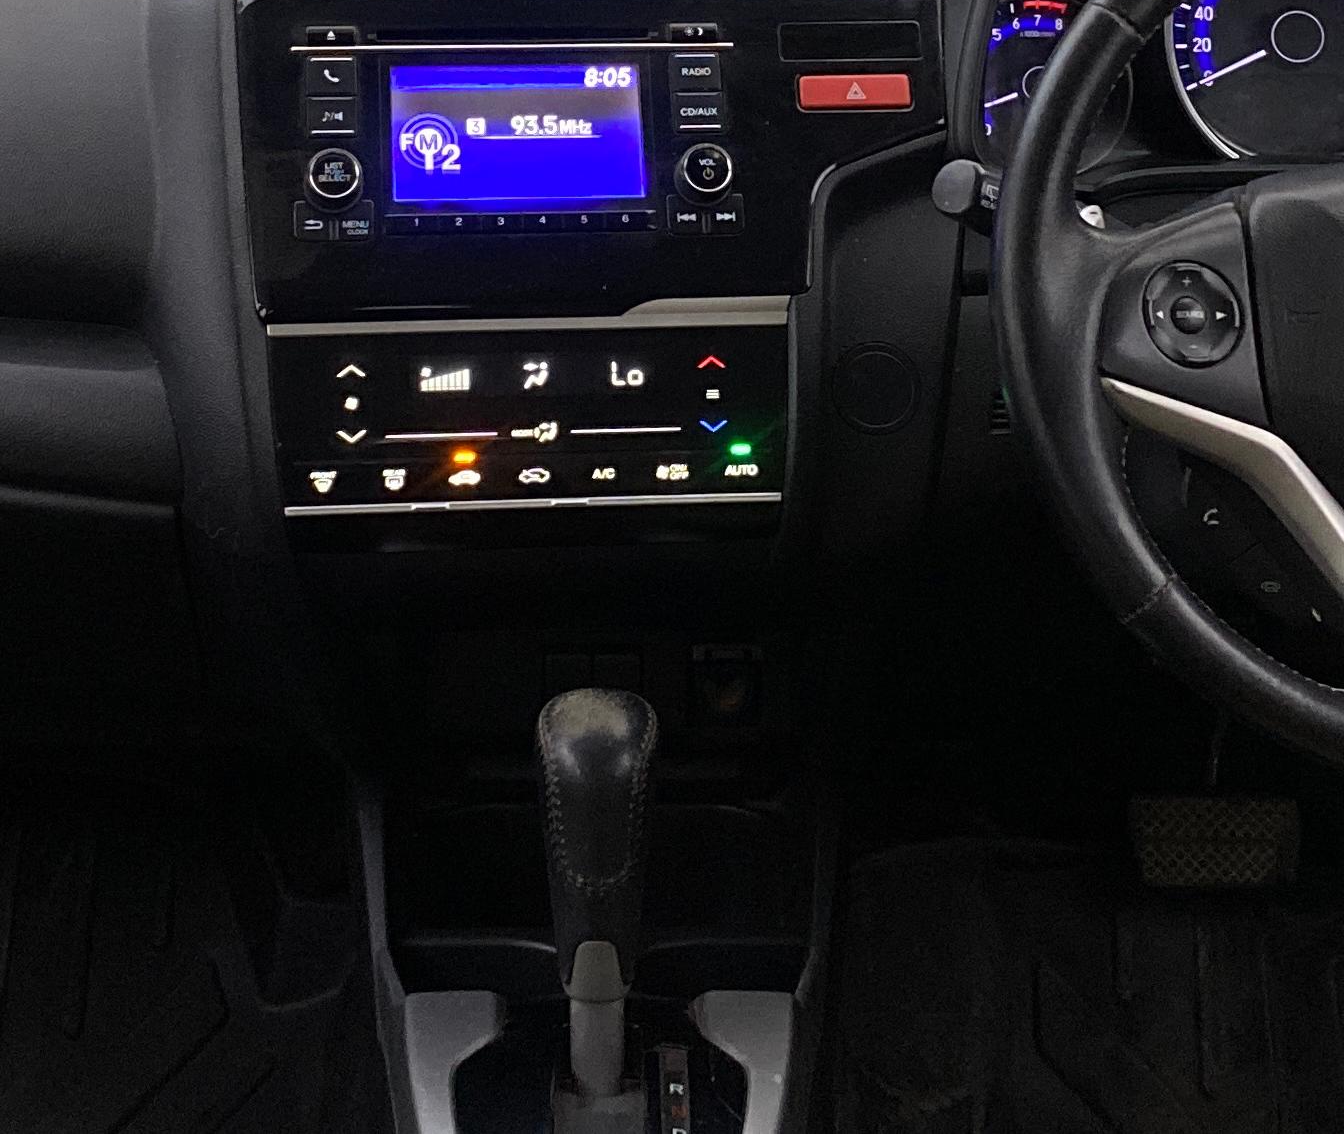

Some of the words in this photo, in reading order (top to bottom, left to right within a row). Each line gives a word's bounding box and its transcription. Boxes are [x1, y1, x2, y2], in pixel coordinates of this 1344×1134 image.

[1194, 5, 1214, 22] 40
[1012, 17, 1021, 30] 6
[1033, 14, 1042, 27] 7
[1054, 18, 1064, 31] 8
[991, 27, 1002, 41] 5
[1192, 37, 1212, 53] 20
[583, 66, 632, 88] 8:05
[681, 67, 712, 77] RADIO
[680, 107, 718, 117] CD/AUX
[698, 158, 717, 167] VOL
[414, 217, 420, 227] 1
[455, 217, 463, 226] 2
[497, 216, 505, 226] 3
[538, 215, 547, 224] 4
[580, 214, 588, 224] 5
[621, 214, 630, 223] 6
[342, 220, 370, 229] MENU
[611, 360, 644, 386] Lo
[592, 467, 616, 480] A/C
[724, 463, 759, 477] AUTO
